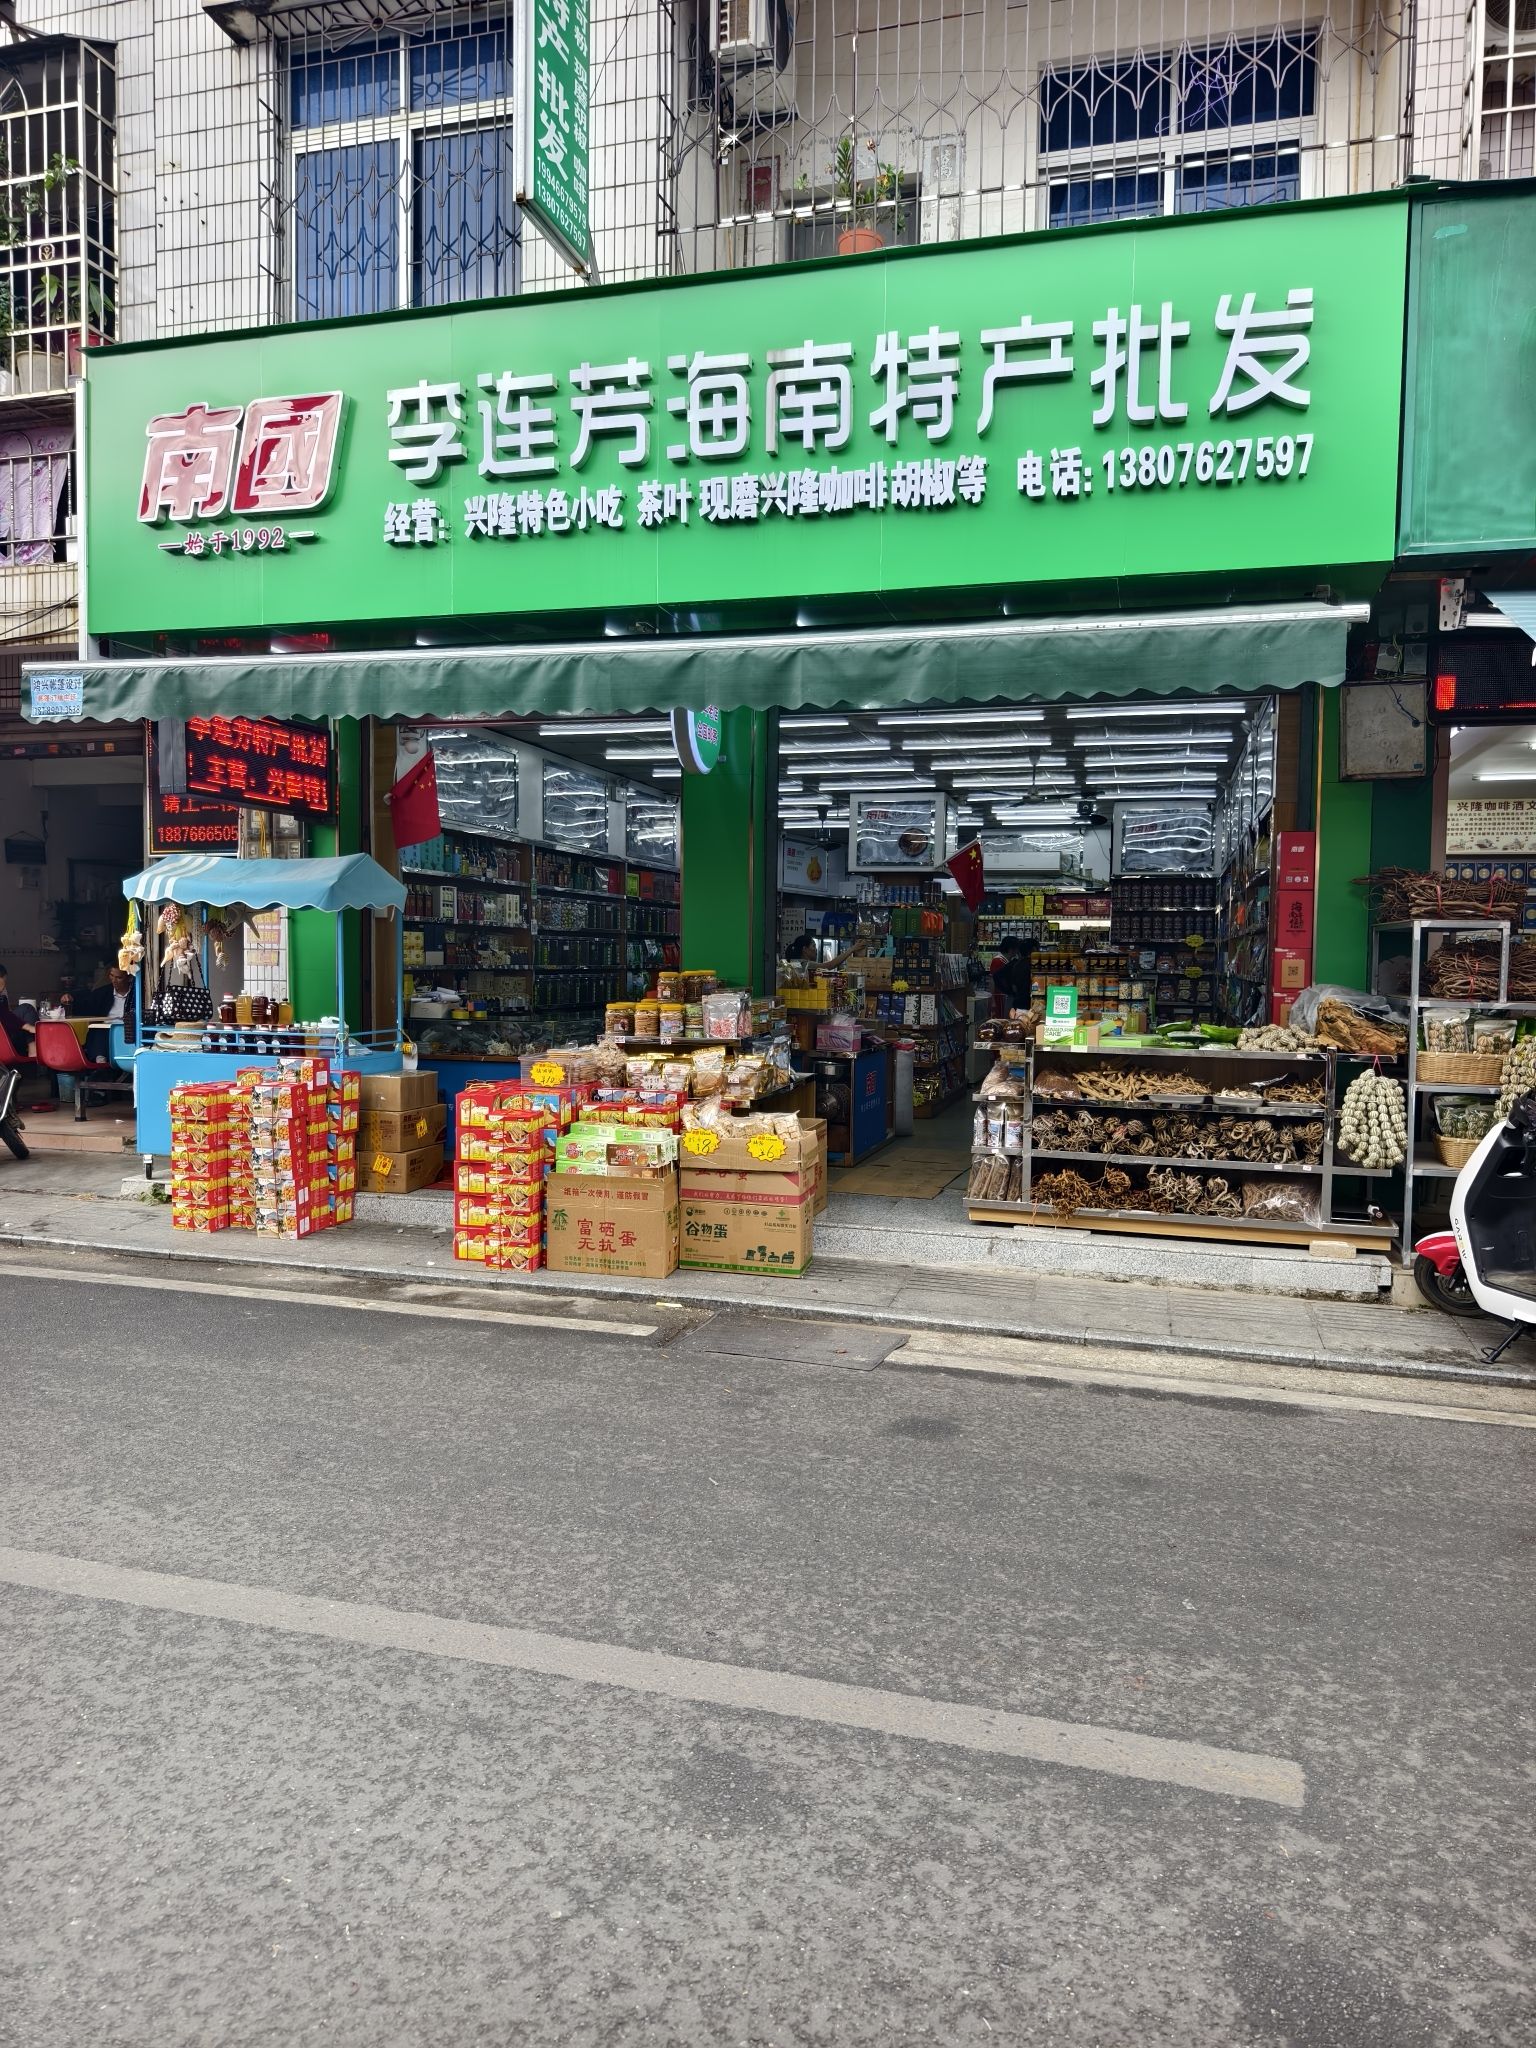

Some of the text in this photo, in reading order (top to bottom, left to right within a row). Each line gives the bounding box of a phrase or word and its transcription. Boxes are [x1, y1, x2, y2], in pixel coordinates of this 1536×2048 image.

[536, 156, 587, 230] 19946679579
[573, 154, 588, 205] 咖啡
[536, 180, 587, 251] 13807627597
[386, 287, 1315, 486] 李连芳海南特产批发
[463, 484, 624, 540] 兴隆特色小吃
[636, 477, 693, 528] 茶叶
[1102, 433, 1315, 493] 13807627597
[1457, 801, 1536, 811] 兴隆咖啡酒文
[577, 1218, 616, 1237] 富硒
[618, 1230, 638, 1247] 蛋
[685, 1221, 728, 1239] 谷物蛋
[577, 1238, 617, 1253] 无抗
